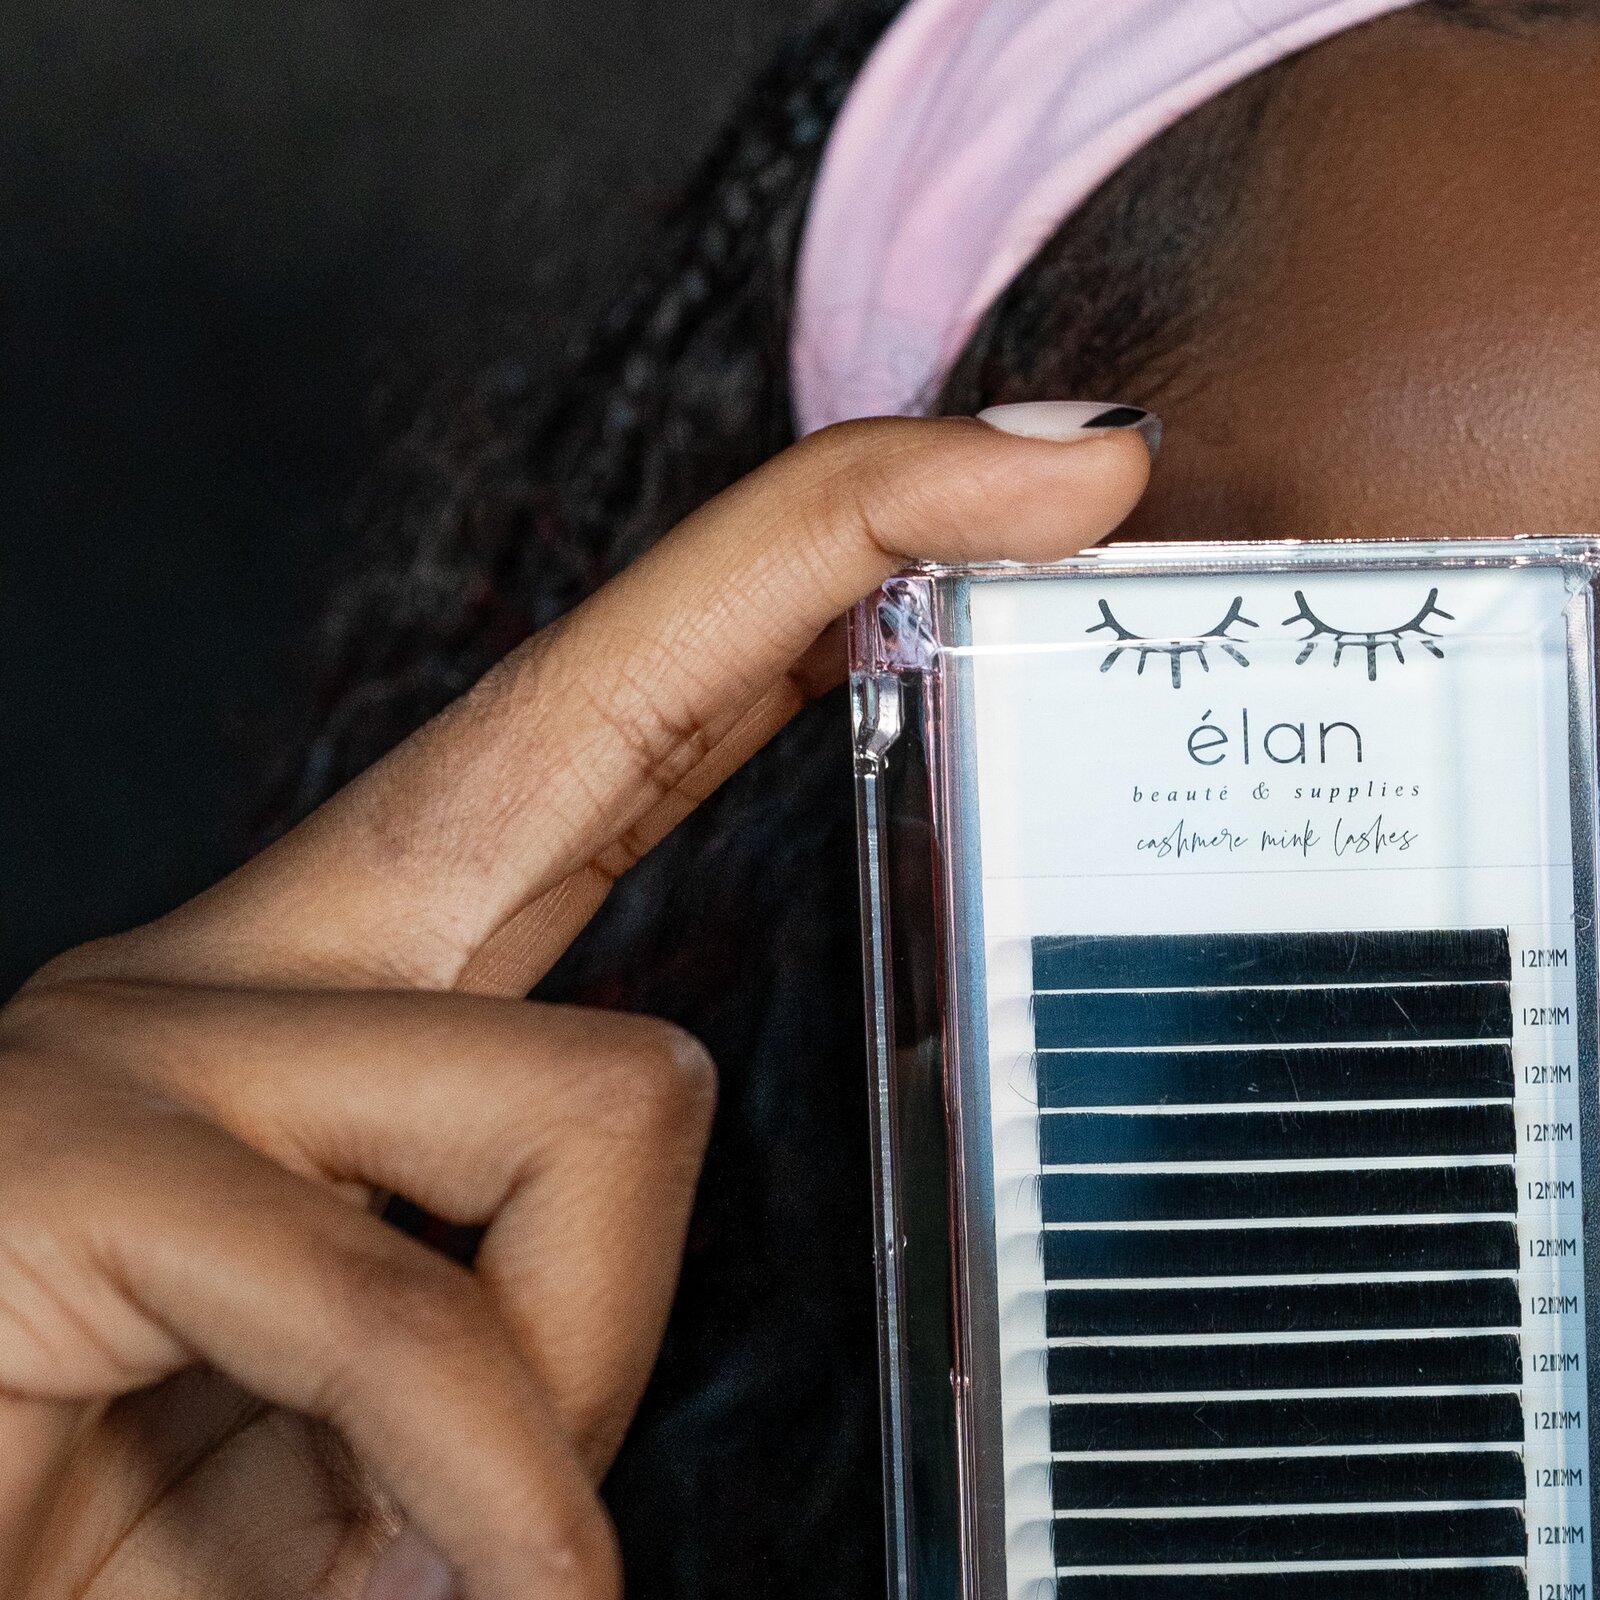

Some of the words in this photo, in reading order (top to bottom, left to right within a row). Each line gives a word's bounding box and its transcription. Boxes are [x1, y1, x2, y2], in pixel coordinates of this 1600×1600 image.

[1187, 708, 1362, 766] élan
[1132, 785, 1229, 803] beauté
[1252, 781, 1270, 800] &
[1293, 780, 1420, 803] supplies
[1136, 818, 1249, 859] cashmere
[1260, 818, 1321, 858] mink
[1333, 813, 1419, 857] lashes
